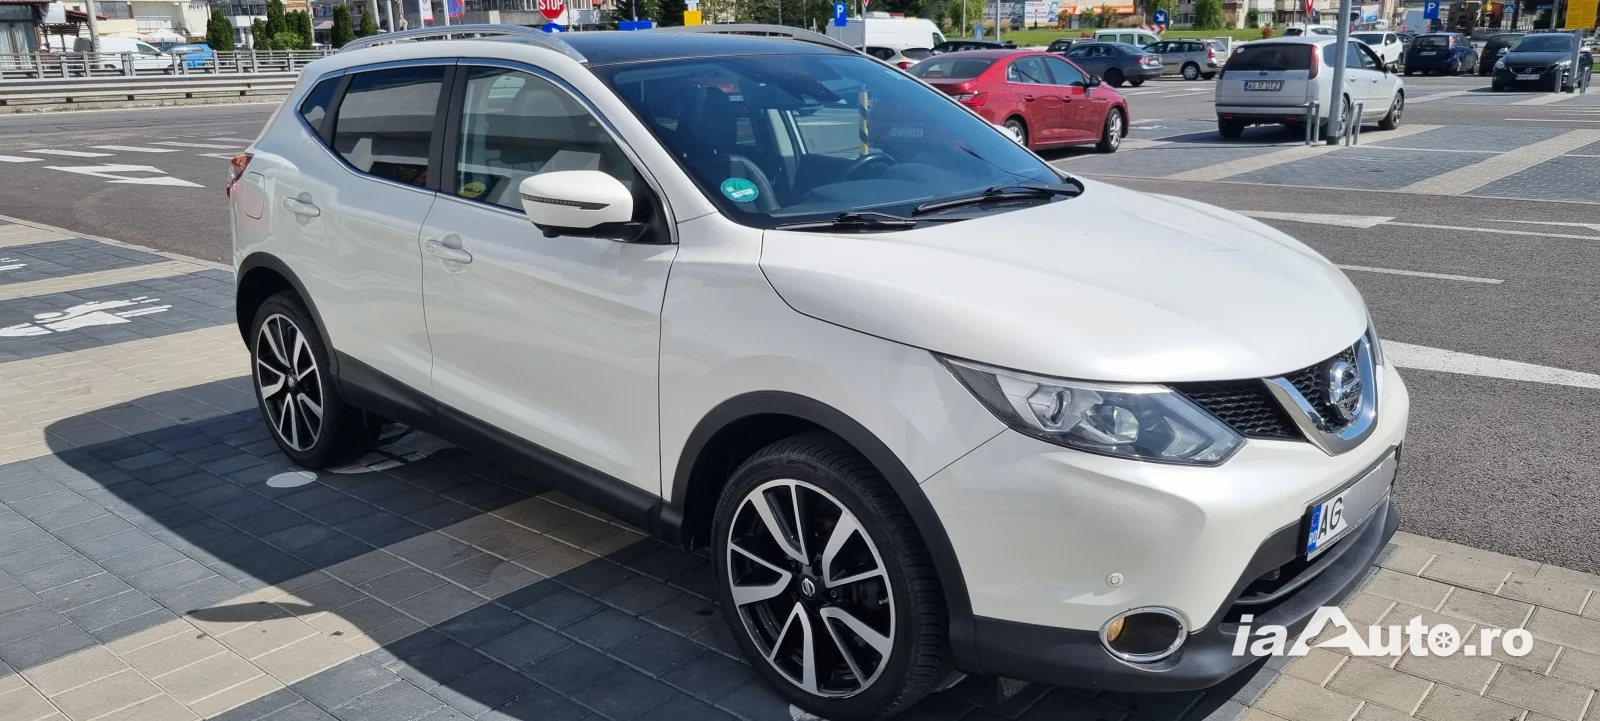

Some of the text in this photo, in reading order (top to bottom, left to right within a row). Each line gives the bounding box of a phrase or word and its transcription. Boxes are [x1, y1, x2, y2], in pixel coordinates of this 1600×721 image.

[540, 0, 563, 10] STOP
[1427, 2, 1436, 13] P
[837, 5, 844, 18] P
[1318, 496, 1343, 539] AG
